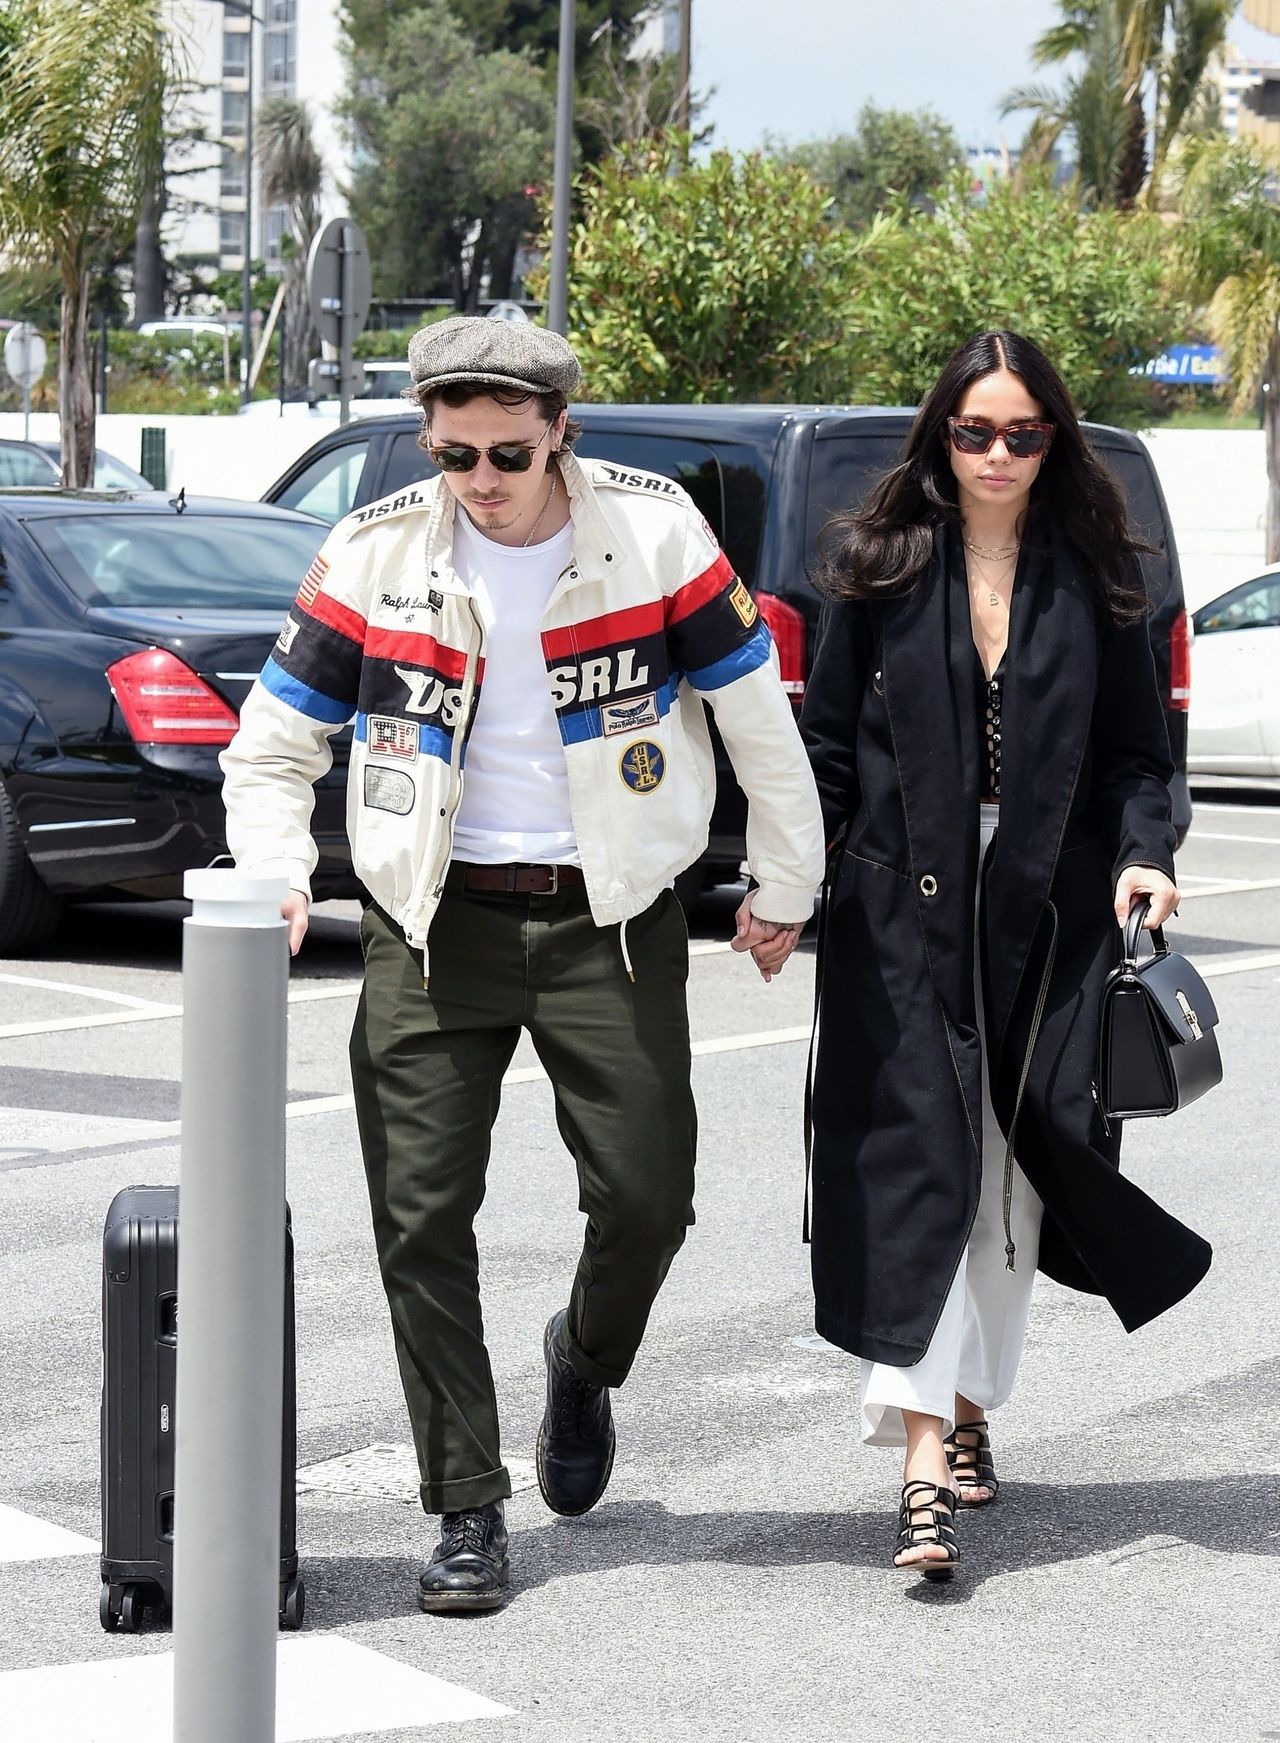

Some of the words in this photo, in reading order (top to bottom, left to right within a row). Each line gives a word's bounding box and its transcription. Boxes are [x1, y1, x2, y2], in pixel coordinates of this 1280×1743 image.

[601, 465, 677, 495] USRL
[351, 491, 424, 524] USRL
[381, 593, 410, 612] Ralph
[405, 726, 416, 737] 67
